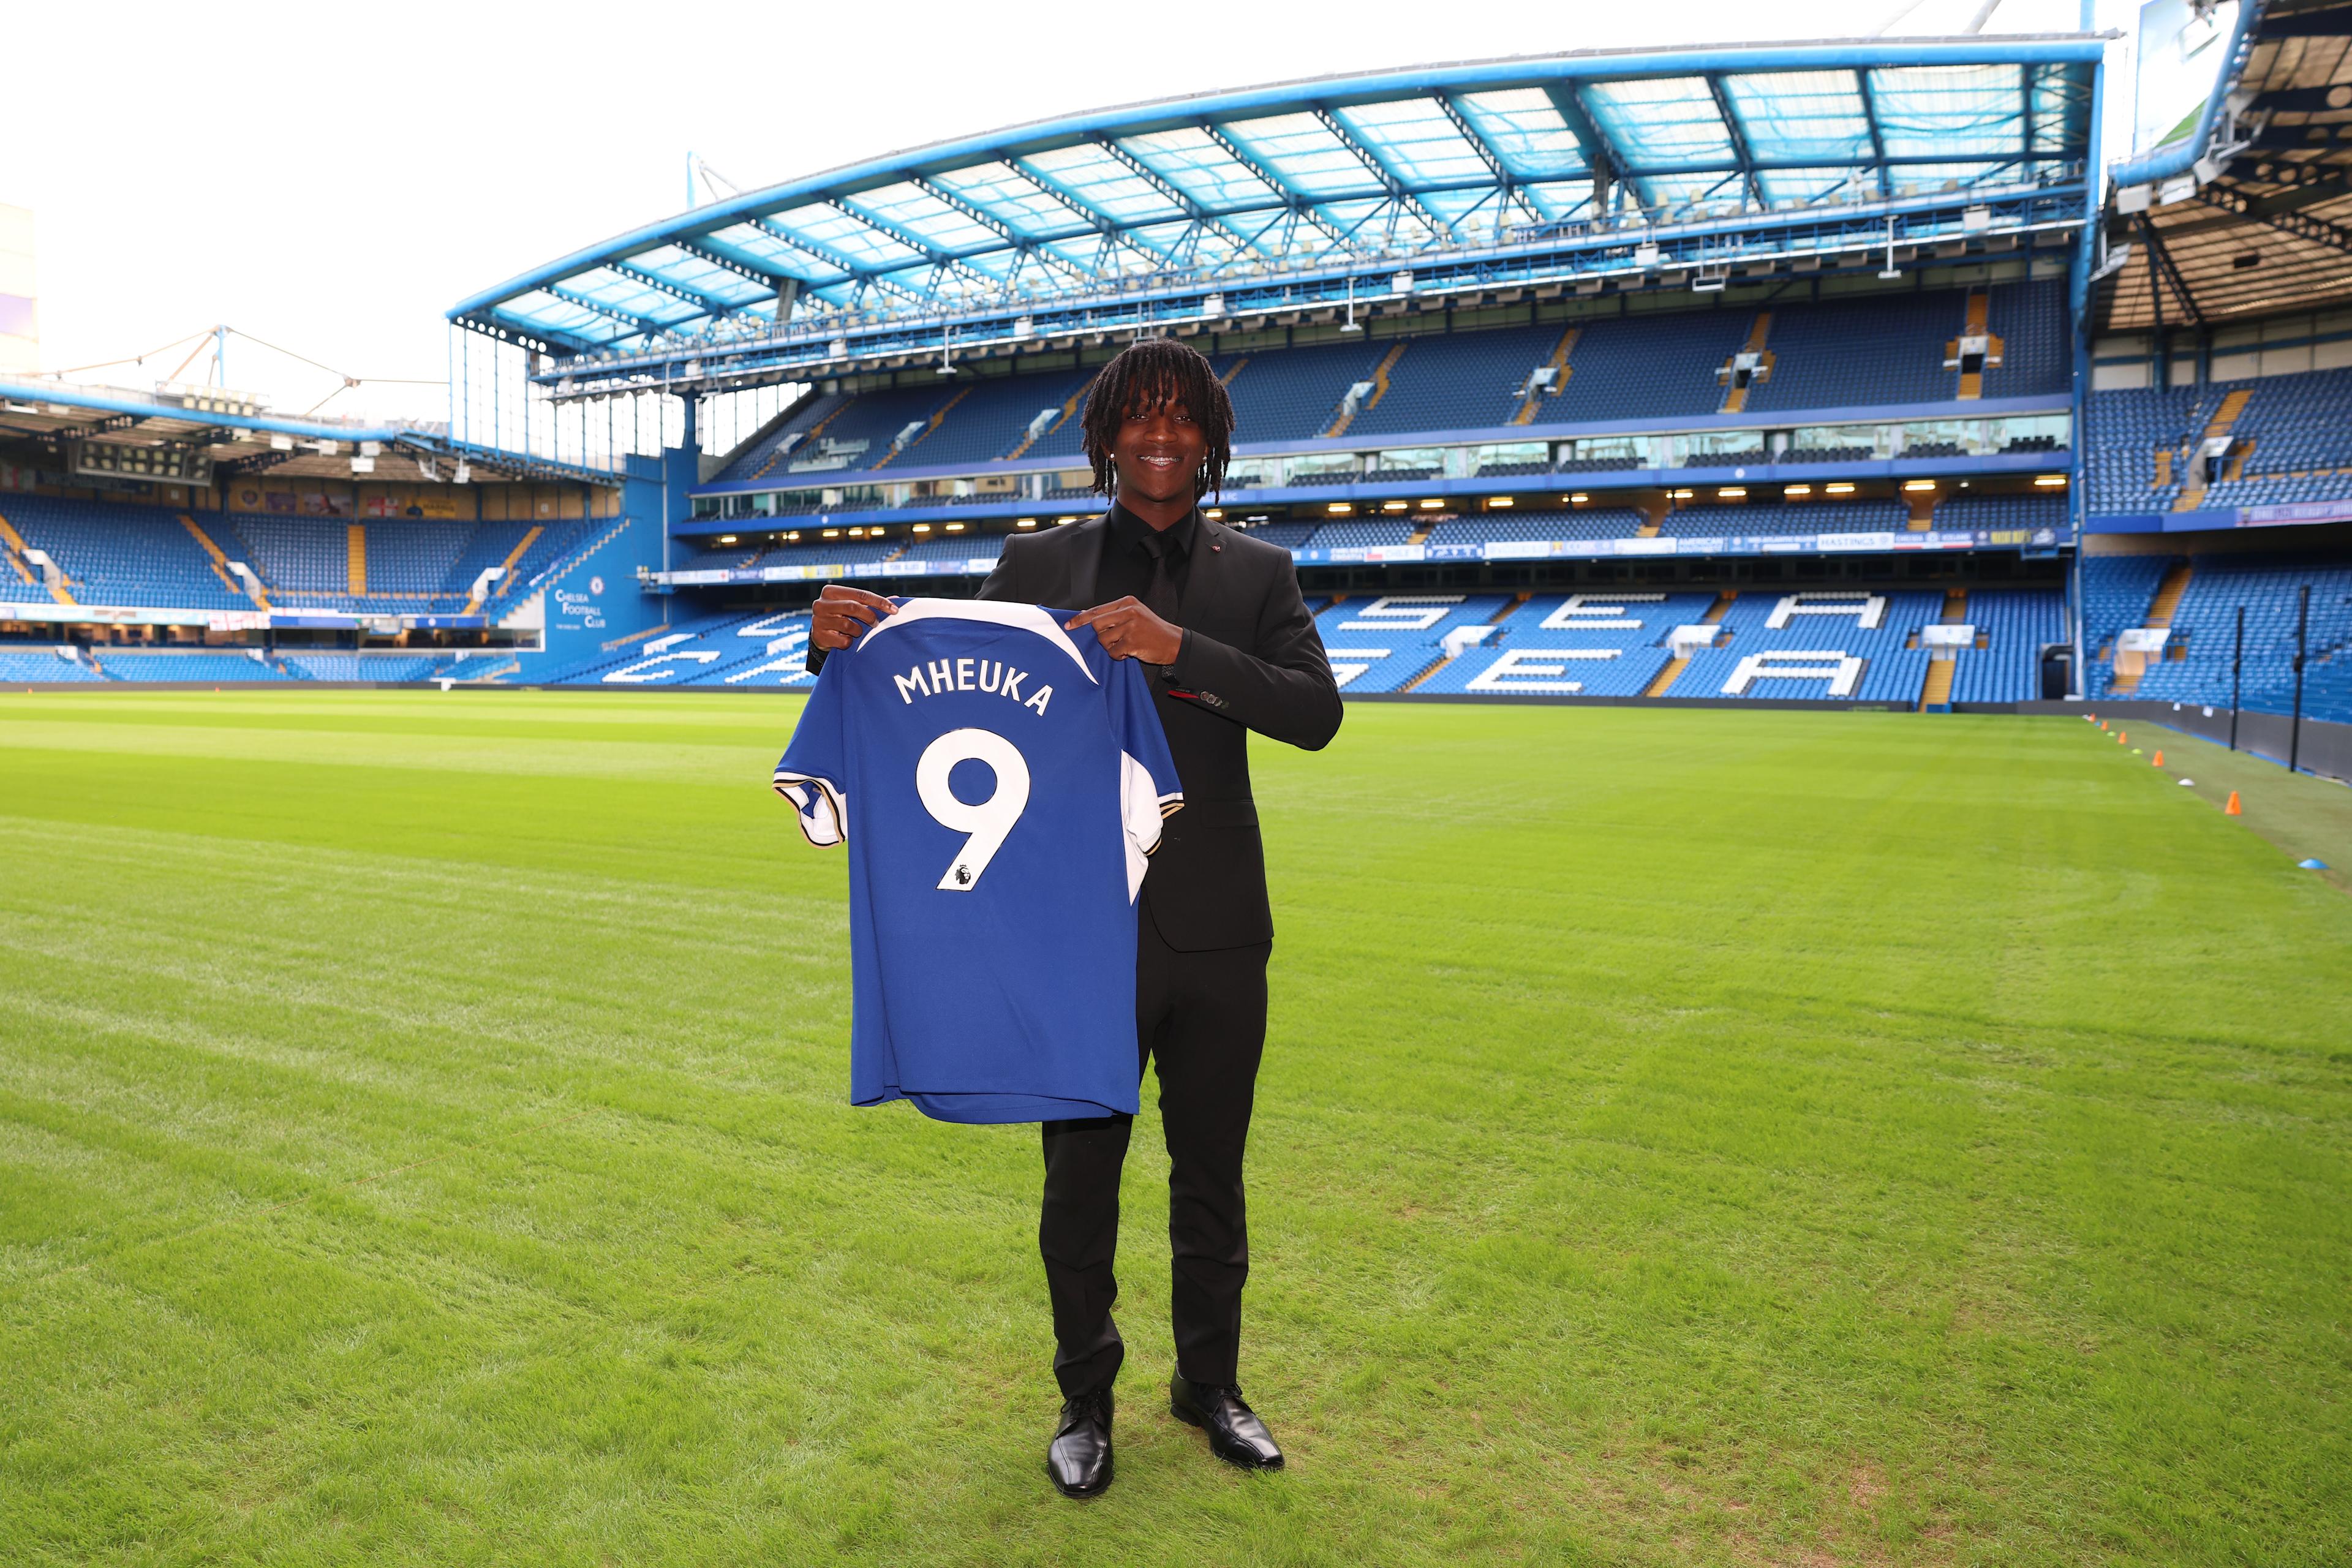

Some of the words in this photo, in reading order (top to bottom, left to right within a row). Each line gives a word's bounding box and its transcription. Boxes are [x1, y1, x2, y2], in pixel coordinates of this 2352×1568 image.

[1678, 537, 1723, 545] AMERICAN
[1821, 537, 1875, 546] HASTINGS
[555, 589, 589, 603] CHELSEA
[562, 601, 601, 616] FOOTBALL
[584, 615, 606, 628] CLUB
[893, 658, 1054, 717] MHEUKA
[915, 727, 1031, 892] 9
